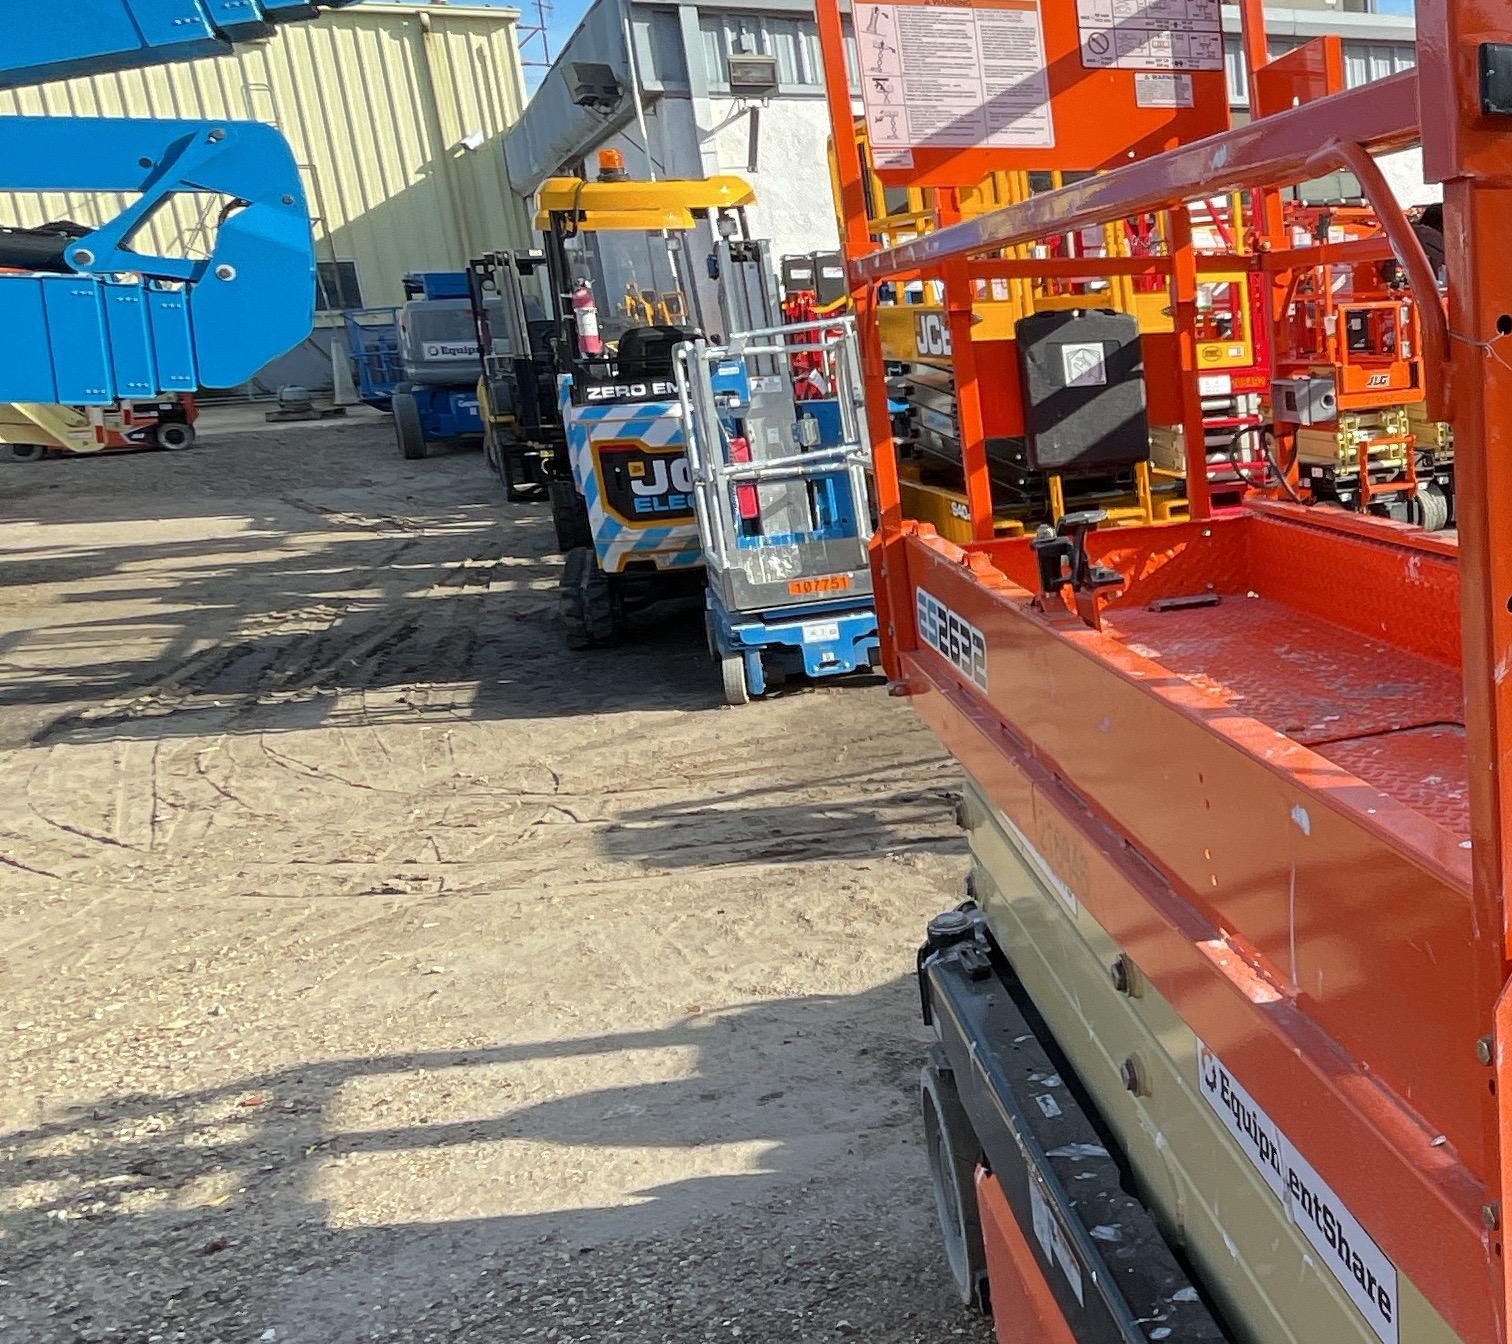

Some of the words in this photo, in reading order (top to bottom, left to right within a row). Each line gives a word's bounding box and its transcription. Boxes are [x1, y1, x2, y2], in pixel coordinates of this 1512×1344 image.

[586, 382, 647, 401] ZERO
[652, 381, 690, 395] EM
[630, 458, 693, 496] JC
